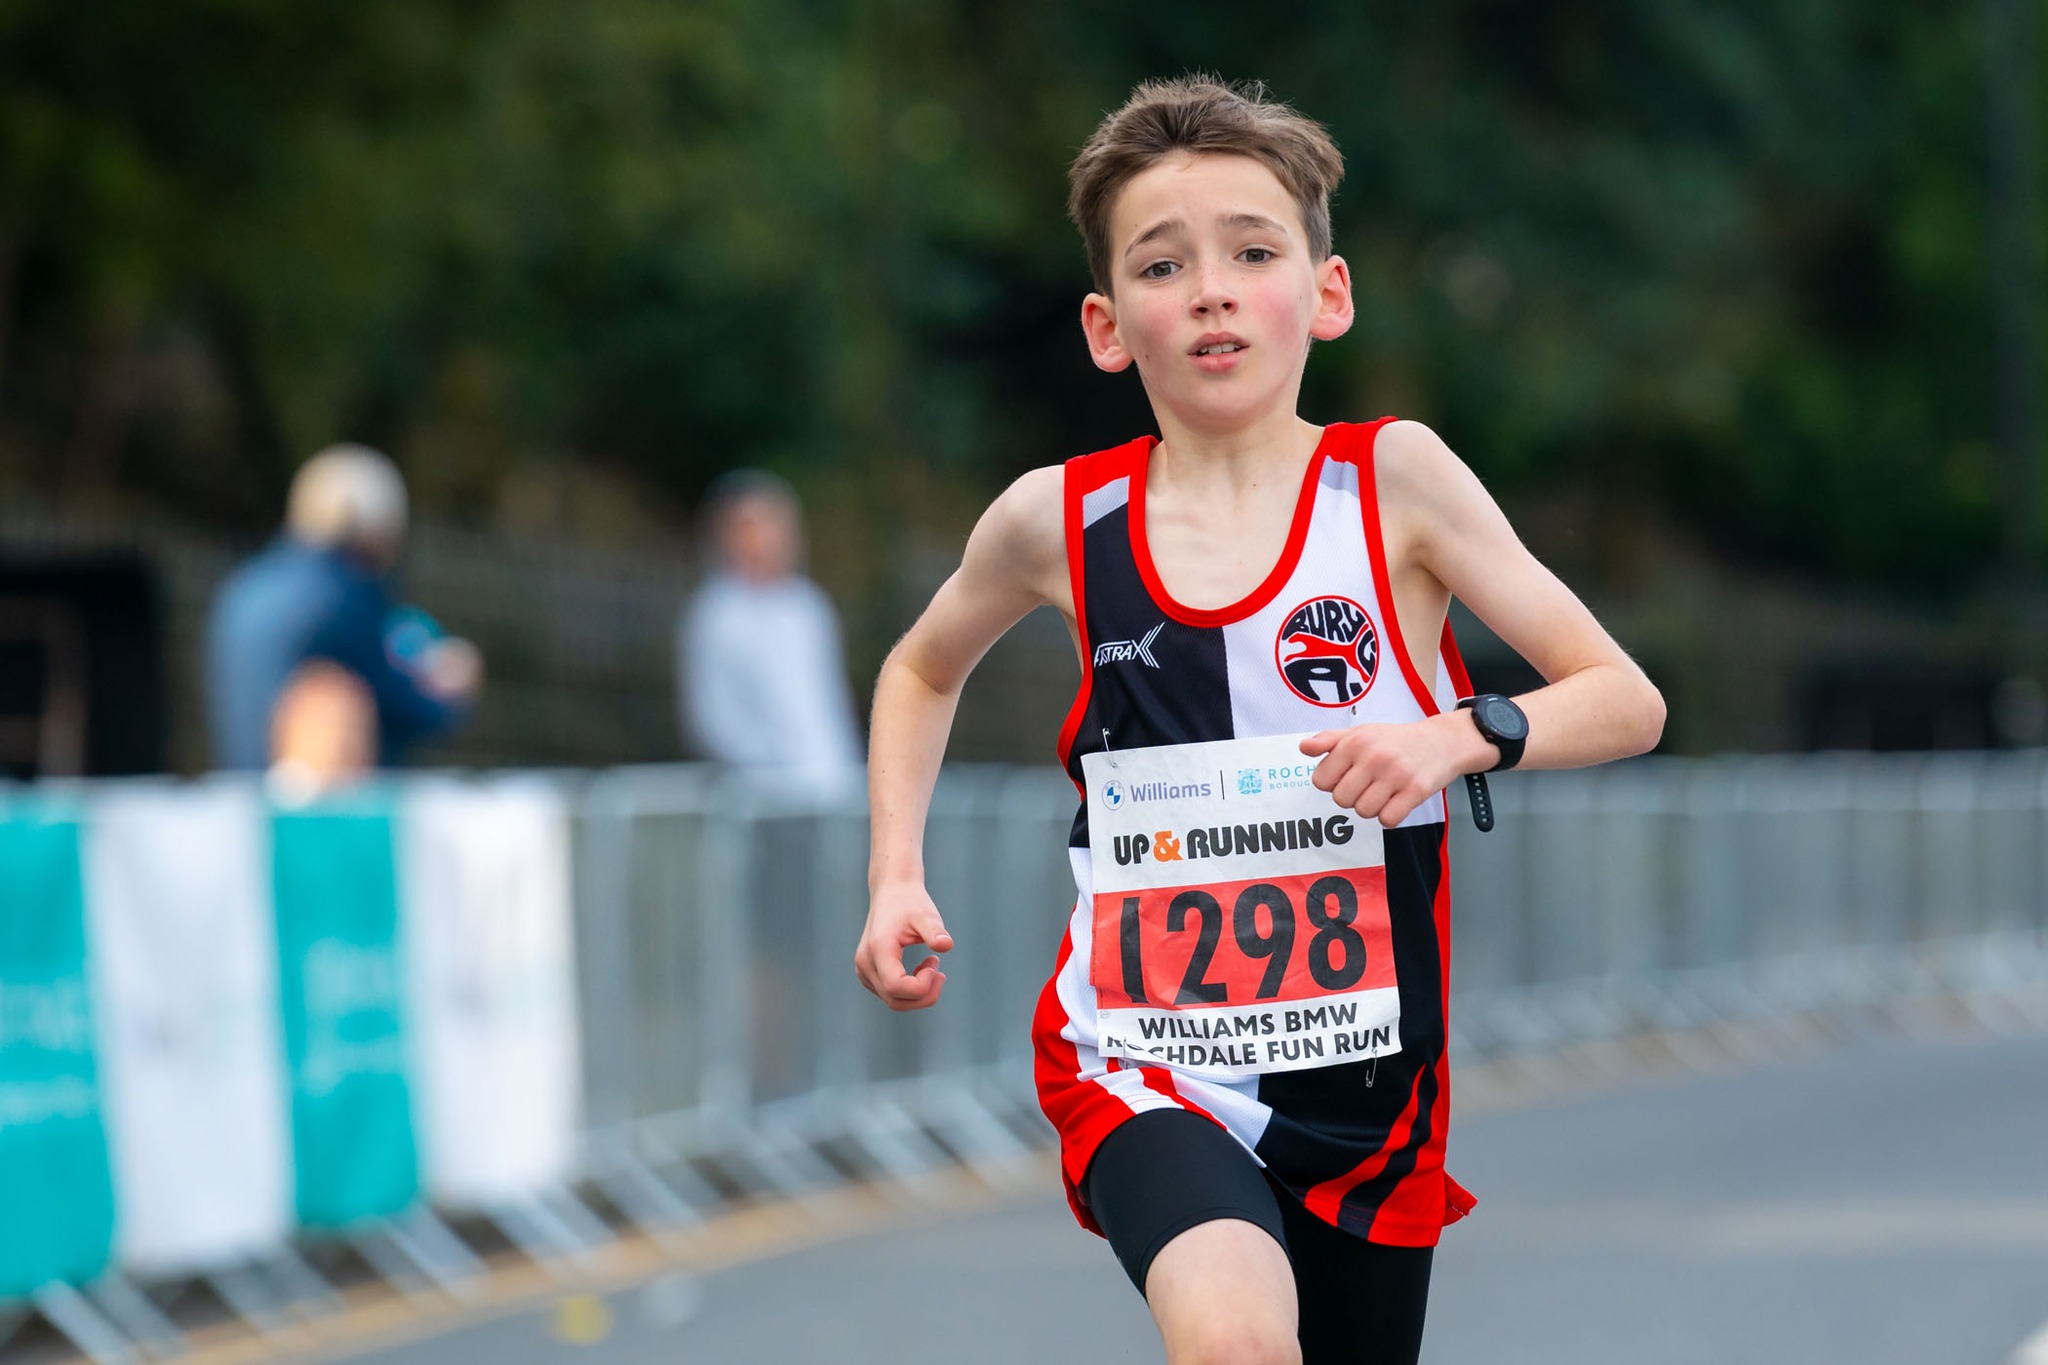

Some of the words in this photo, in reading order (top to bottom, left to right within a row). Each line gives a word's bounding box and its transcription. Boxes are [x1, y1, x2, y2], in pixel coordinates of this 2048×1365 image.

[1282, 600, 1366, 643] BURY
[1130, 782, 1211, 803] Williams
[1113, 833, 1150, 866] UP
[1187, 815, 1354, 859] RUNNING
[1120, 876, 1367, 1006] 1298
[1138, 1013, 1275, 1040] WILLIAMS
[1285, 1002, 1358, 1033] BMW
[1267, 1036, 1324, 1063] FUN
[1334, 1025, 1391, 1055] RUN
